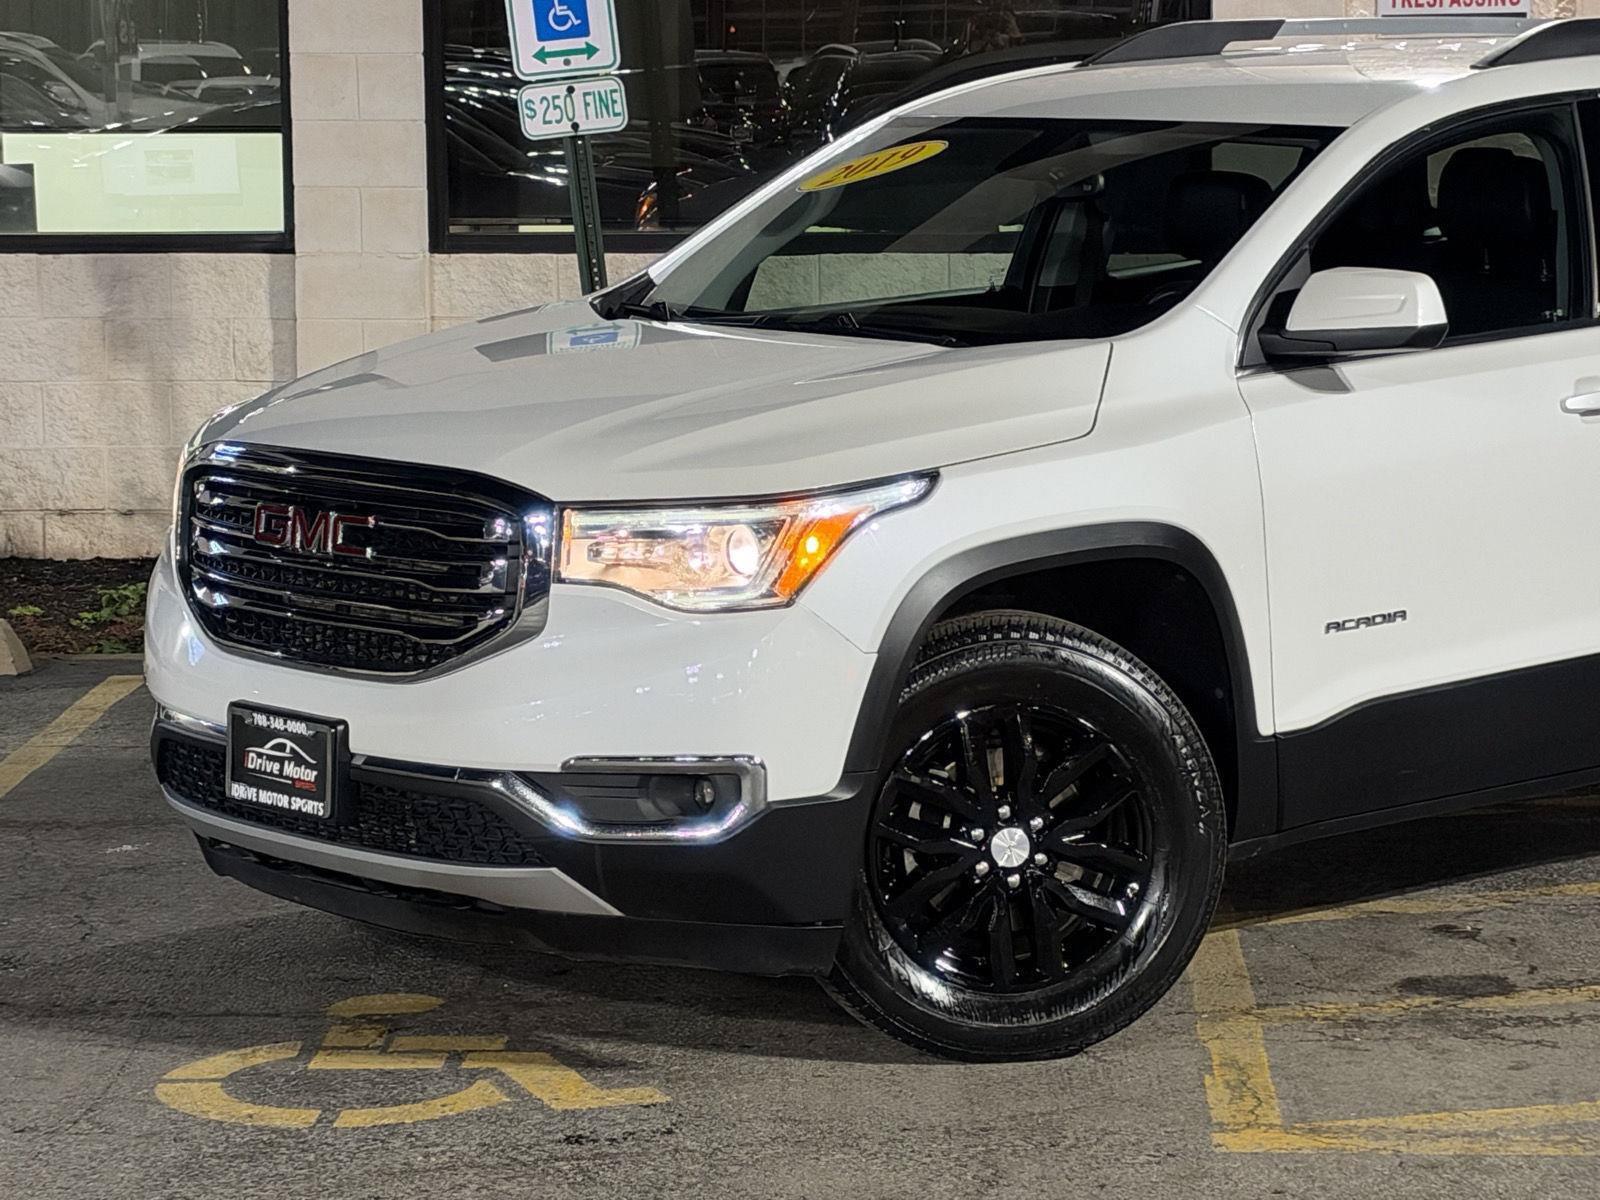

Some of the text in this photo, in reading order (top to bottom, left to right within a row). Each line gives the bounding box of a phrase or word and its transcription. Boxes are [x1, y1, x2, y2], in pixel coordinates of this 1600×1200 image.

[524, 89, 622, 125] $250 FINE
[814, 145, 929, 188] 2019
[254, 502, 376, 559] GMC
[1324, 609, 1407, 635] ACADIA
[282, 760, 318, 782] Motor
[230, 783, 325, 817] IDRIVE MOTOR SPORTS
